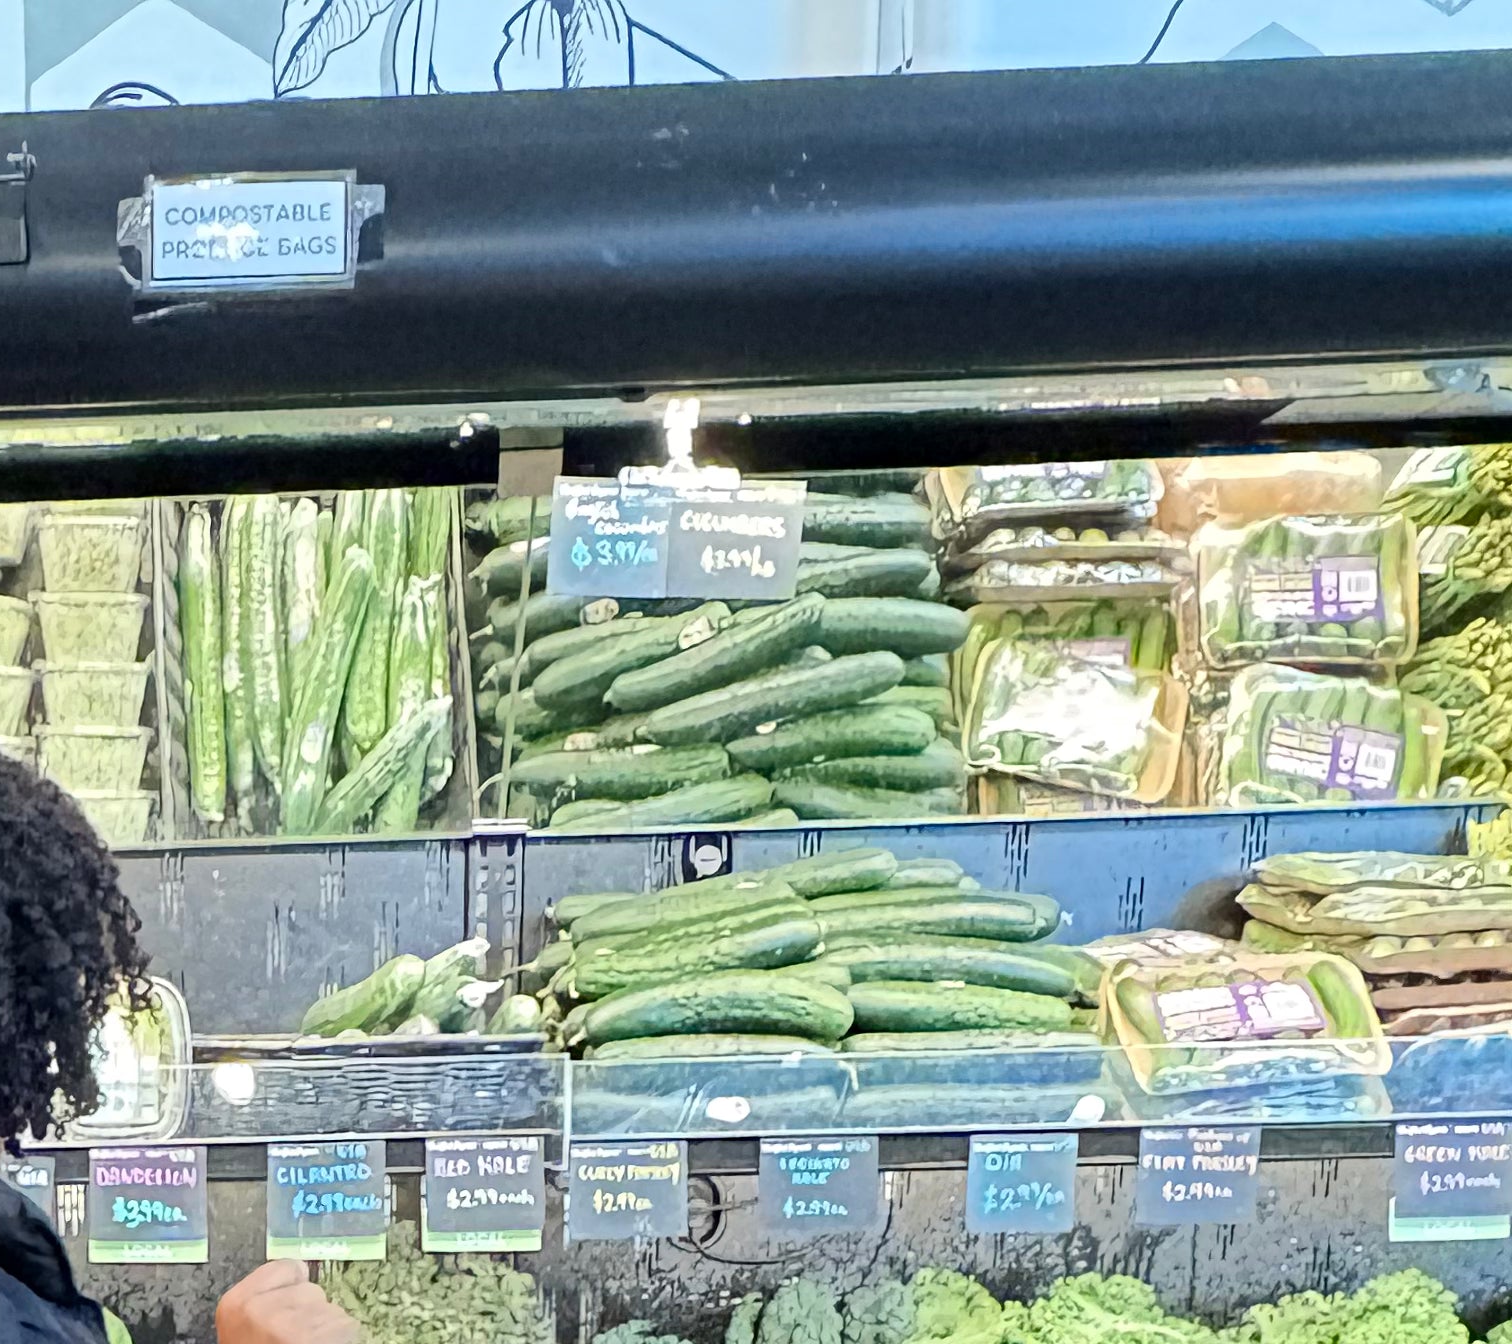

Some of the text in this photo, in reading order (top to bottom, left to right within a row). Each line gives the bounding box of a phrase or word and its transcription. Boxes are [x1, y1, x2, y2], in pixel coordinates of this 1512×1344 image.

[165, 202, 331, 226] COMPOSTABLE
[277, 236, 337, 256] BAGS
[95, 1165, 198, 1189] DANDELION
[276, 1162, 373, 1185] CILANTRO
[434, 1154, 532, 1177] RED KALE
